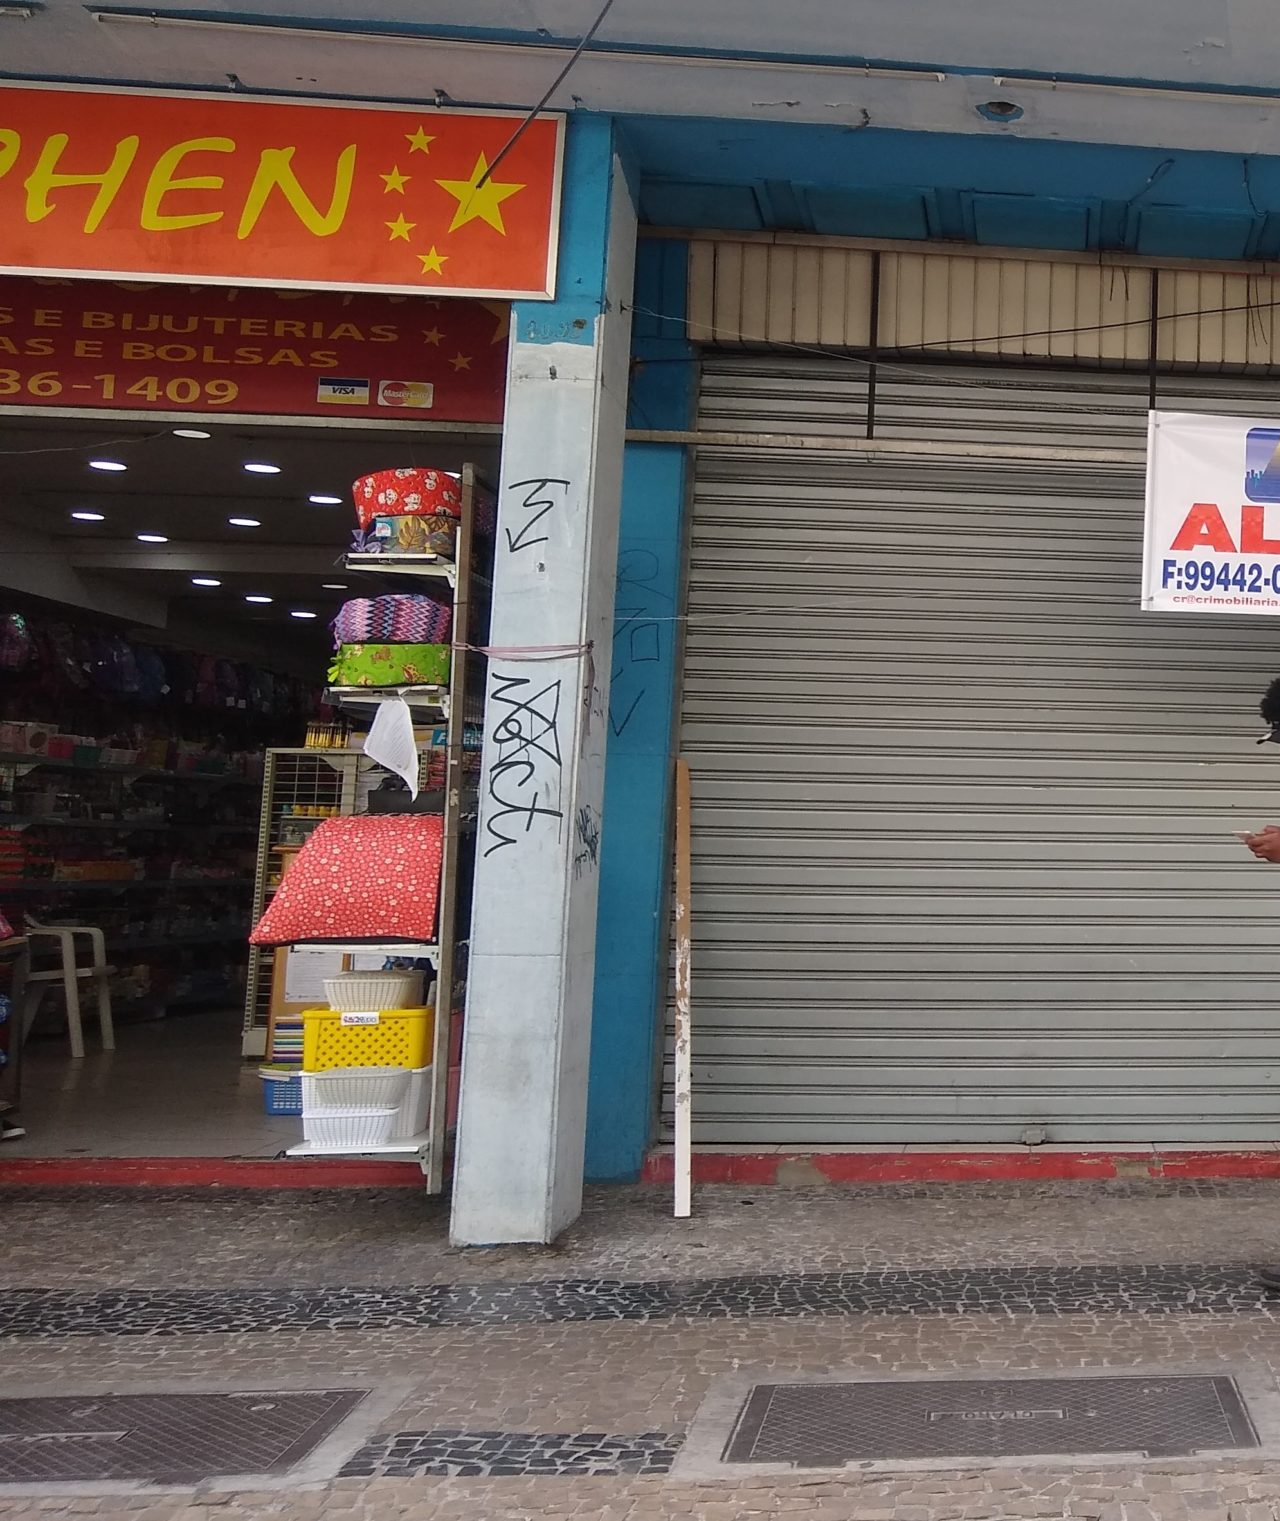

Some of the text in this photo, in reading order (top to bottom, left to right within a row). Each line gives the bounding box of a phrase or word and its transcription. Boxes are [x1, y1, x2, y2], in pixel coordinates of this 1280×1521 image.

[34, 309, 63, 327] E
[82, 311, 399, 342] BIJUTERIAS
[74, 340, 103, 358] E
[122, 342, 338, 368] BOLSAS
[331, 387, 355, 396] VISA
[383, 389, 430, 400] MasterCard
